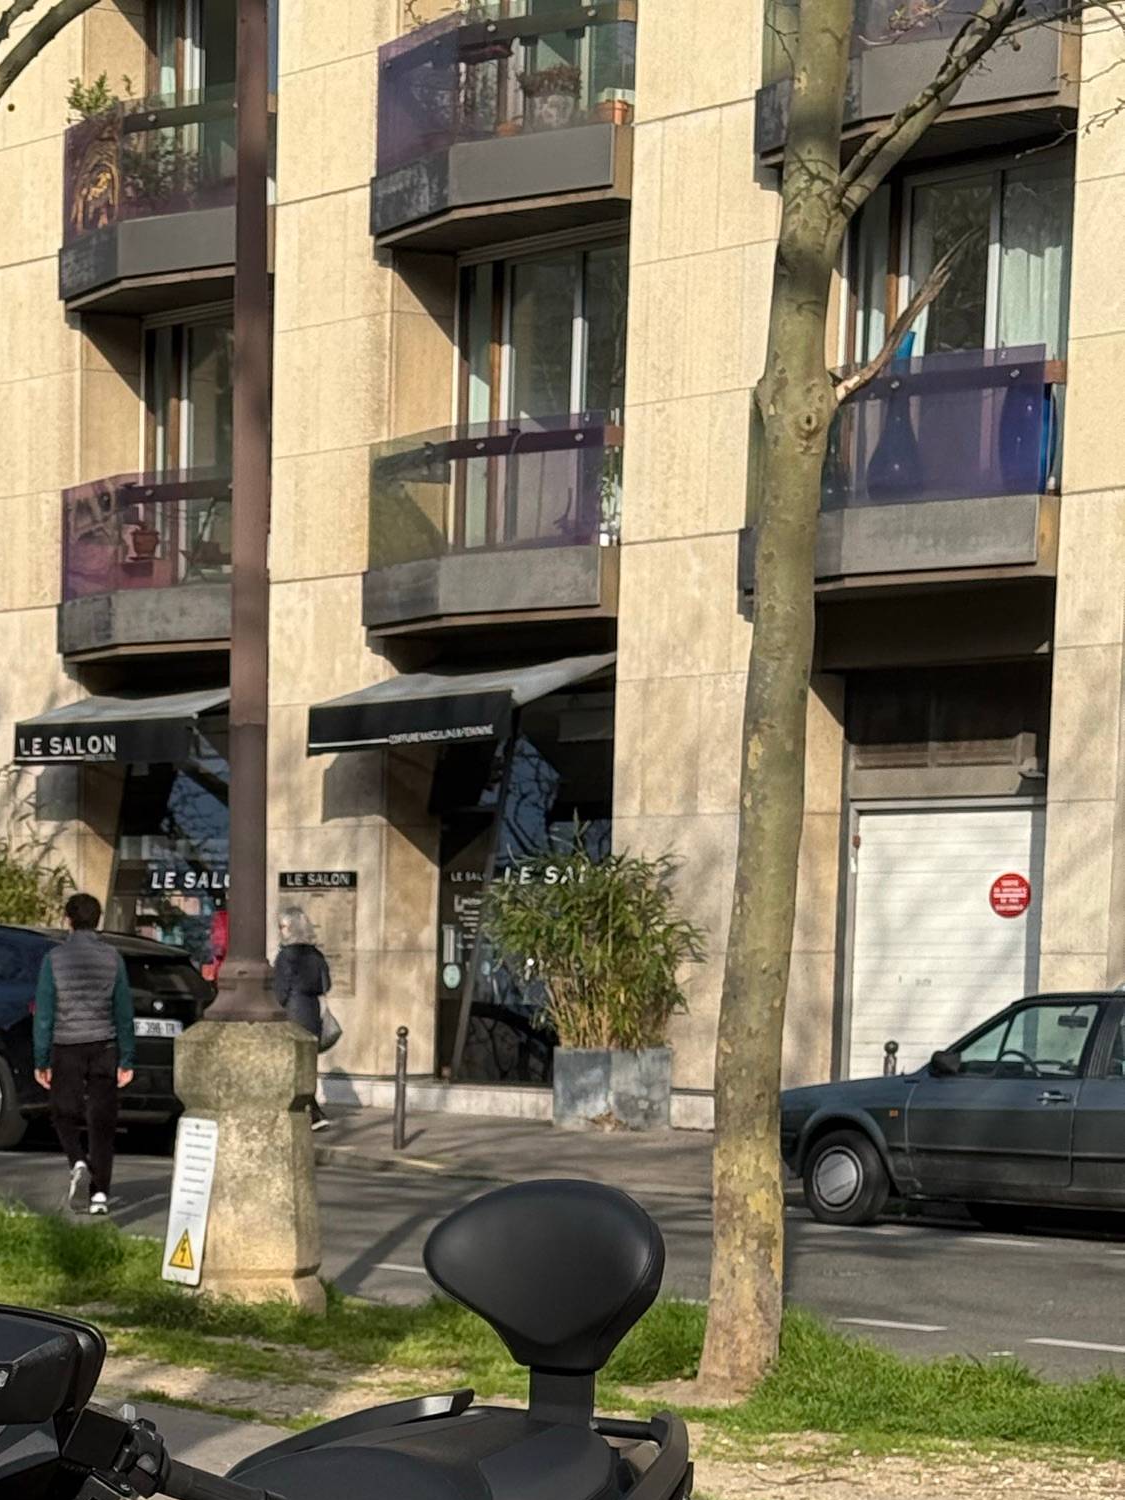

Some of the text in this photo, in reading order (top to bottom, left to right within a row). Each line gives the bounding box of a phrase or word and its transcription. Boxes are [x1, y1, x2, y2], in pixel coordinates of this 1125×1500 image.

[19, 735, 116, 756] LE SALON
[151, 871, 177, 889] LE
[286, 872, 351, 887] LE SALON
